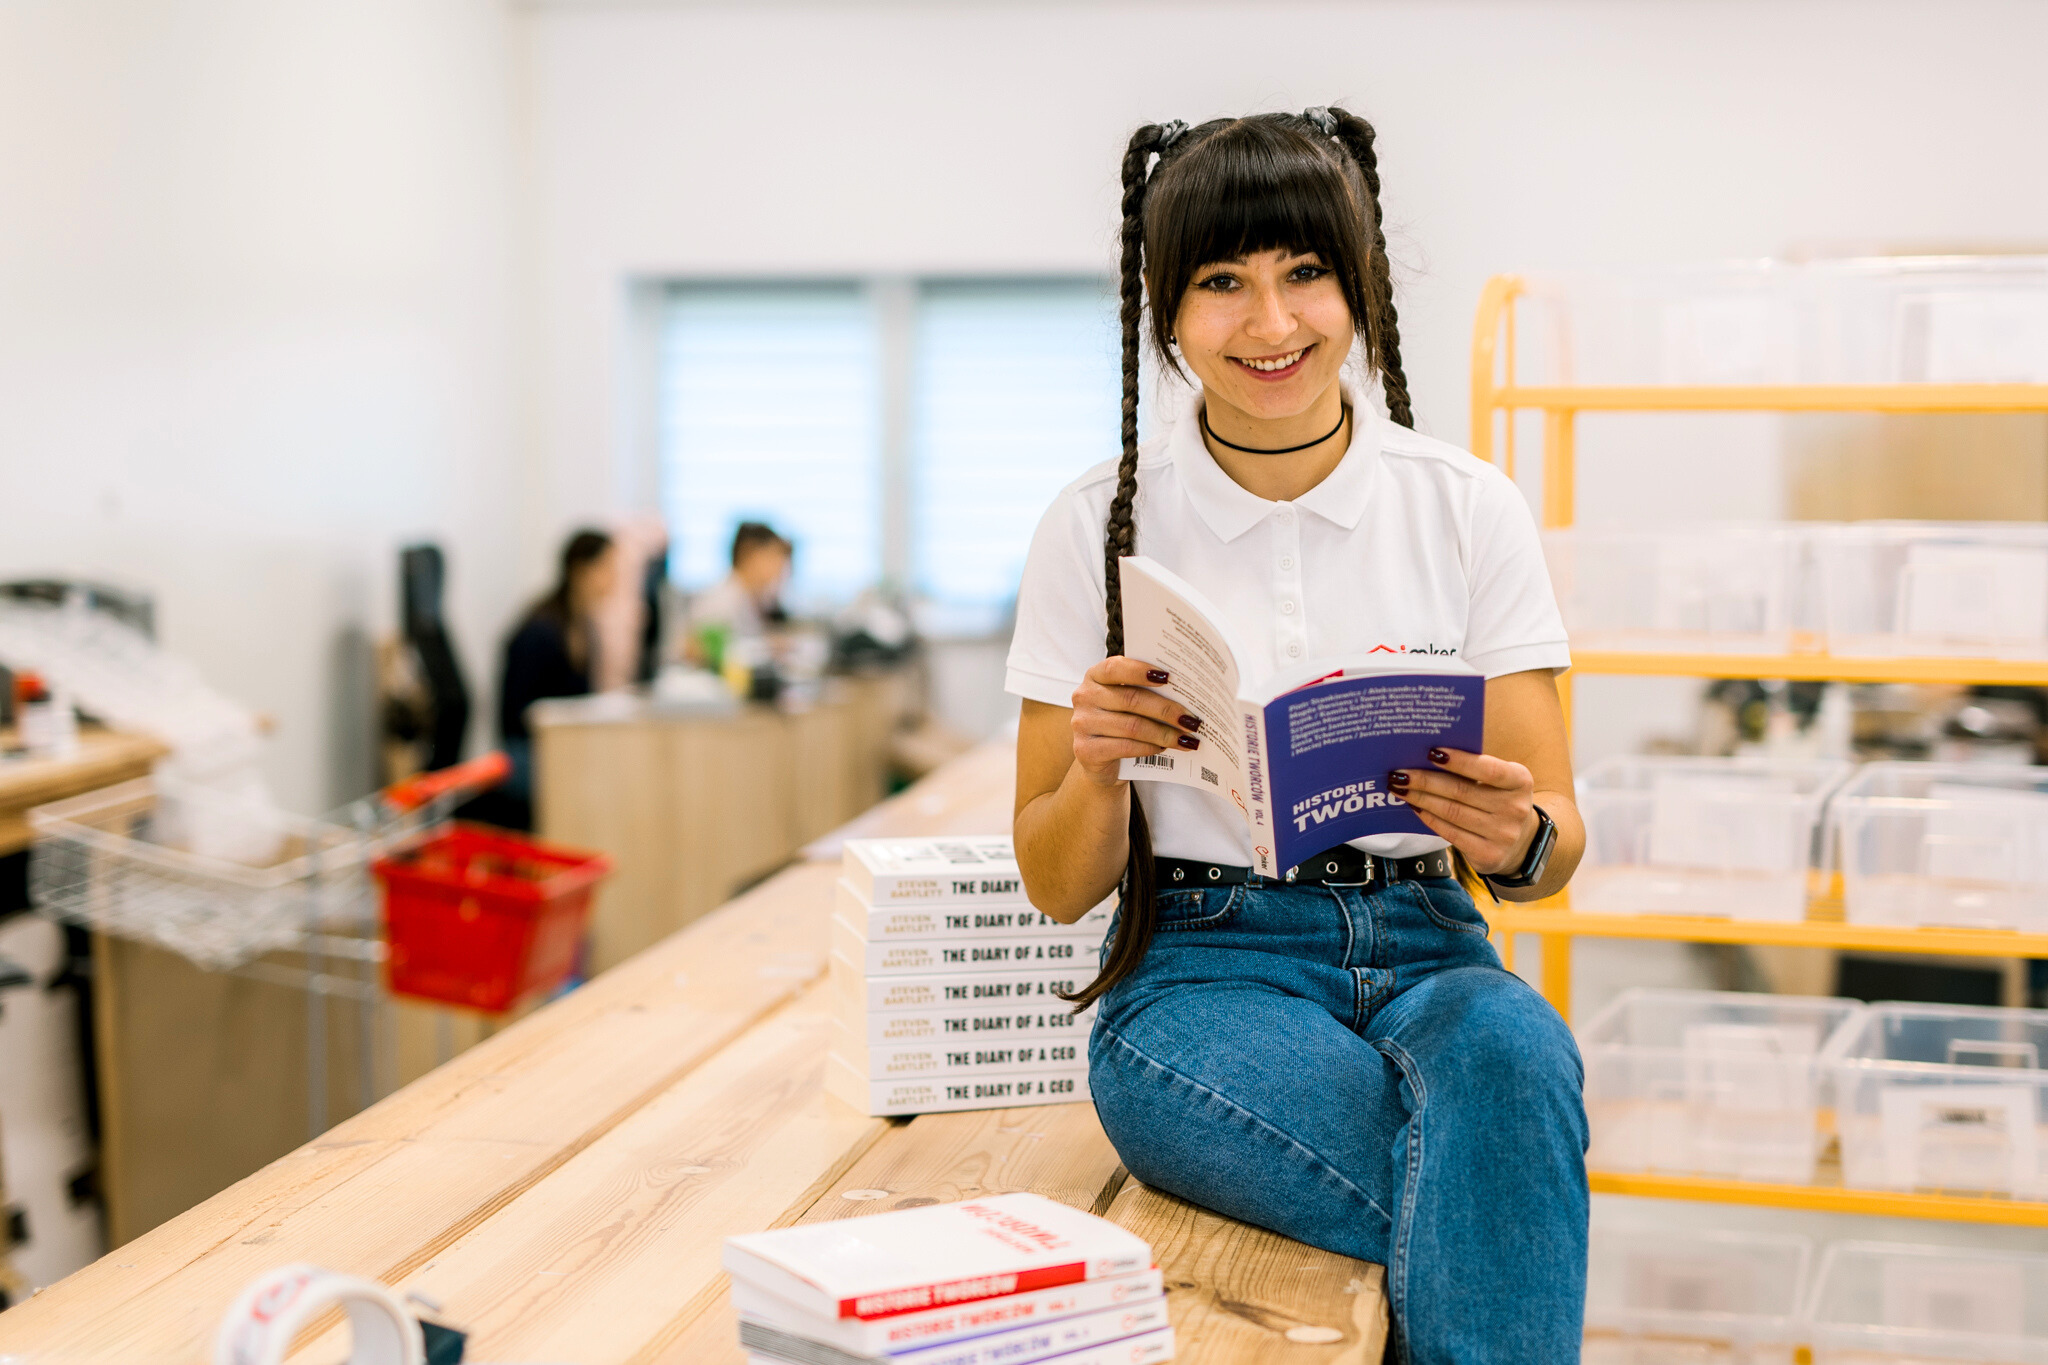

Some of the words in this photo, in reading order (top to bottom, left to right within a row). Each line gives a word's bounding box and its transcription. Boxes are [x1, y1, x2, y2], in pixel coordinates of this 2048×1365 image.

[1245, 714, 1260, 756] HISTORIE
[1249, 758, 1265, 804] TWÓRCÓW
[1293, 780, 1376, 816] HISTORIE
[1293, 792, 1406, 833] TWÓRC
[897, 880, 938, 889] STEVEN
[952, 881, 976, 894] THE
[981, 880, 1020, 893] DIARY
[890, 889, 943, 899] BARTLETT
[891, 914, 931, 923] STEVEN
[946, 915, 970, 928] THE
[975, 913, 1013, 927] DIARY
[1018, 913, 1034, 926] OF
[1039, 912, 1047, 925] A
[885, 924, 937, 933] BARTLETT
[888, 949, 928, 957] STEVEN
[943, 949, 966, 962] THE
[972, 948, 1010, 961] DIARY
[1015, 946, 1032, 960] OF
[1036, 946, 1043, 958] A
[1048, 945, 1073, 958] CEO
[882, 958, 934, 967] BARTLETT
[891, 986, 930, 995] STEVEN
[944, 987, 968, 1000] THE
[973, 985, 1011, 998] DIARY
[1016, 983, 1033, 996] OF
[1037, 982, 1044, 995] A
[1050, 981, 1074, 995] CEO
[884, 995, 936, 1005] BARTLETT
[890, 1019, 930, 1028] STEVEN
[944, 1020, 968, 1032] THE
[973, 1018, 1011, 1031] DIARY
[1016, 1016, 1033, 1029] OF
[1037, 1015, 1044, 1028] A
[1049, 1014, 1074, 1027] CEO
[884, 1028, 935, 1038] BARTLETT
[892, 1053, 932, 1061] STEVEN
[946, 1053, 970, 1066] THE
[975, 1051, 1013, 1064] DIARY
[1018, 1049, 1034, 1062] OF
[1039, 1048, 1046, 1061] A
[1051, 1047, 1076, 1060] CEO
[886, 1061, 938, 1072] BARTLETT
[893, 1086, 932, 1095] STEVEN
[946, 1086, 970, 1099] THE
[975, 1084, 1012, 1097] DIARY
[1017, 1082, 1033, 1095] OF
[1037, 1081, 1045, 1094] A
[1050, 1080, 1074, 1093] CEO
[887, 1096, 938, 1106] BARTLETT
